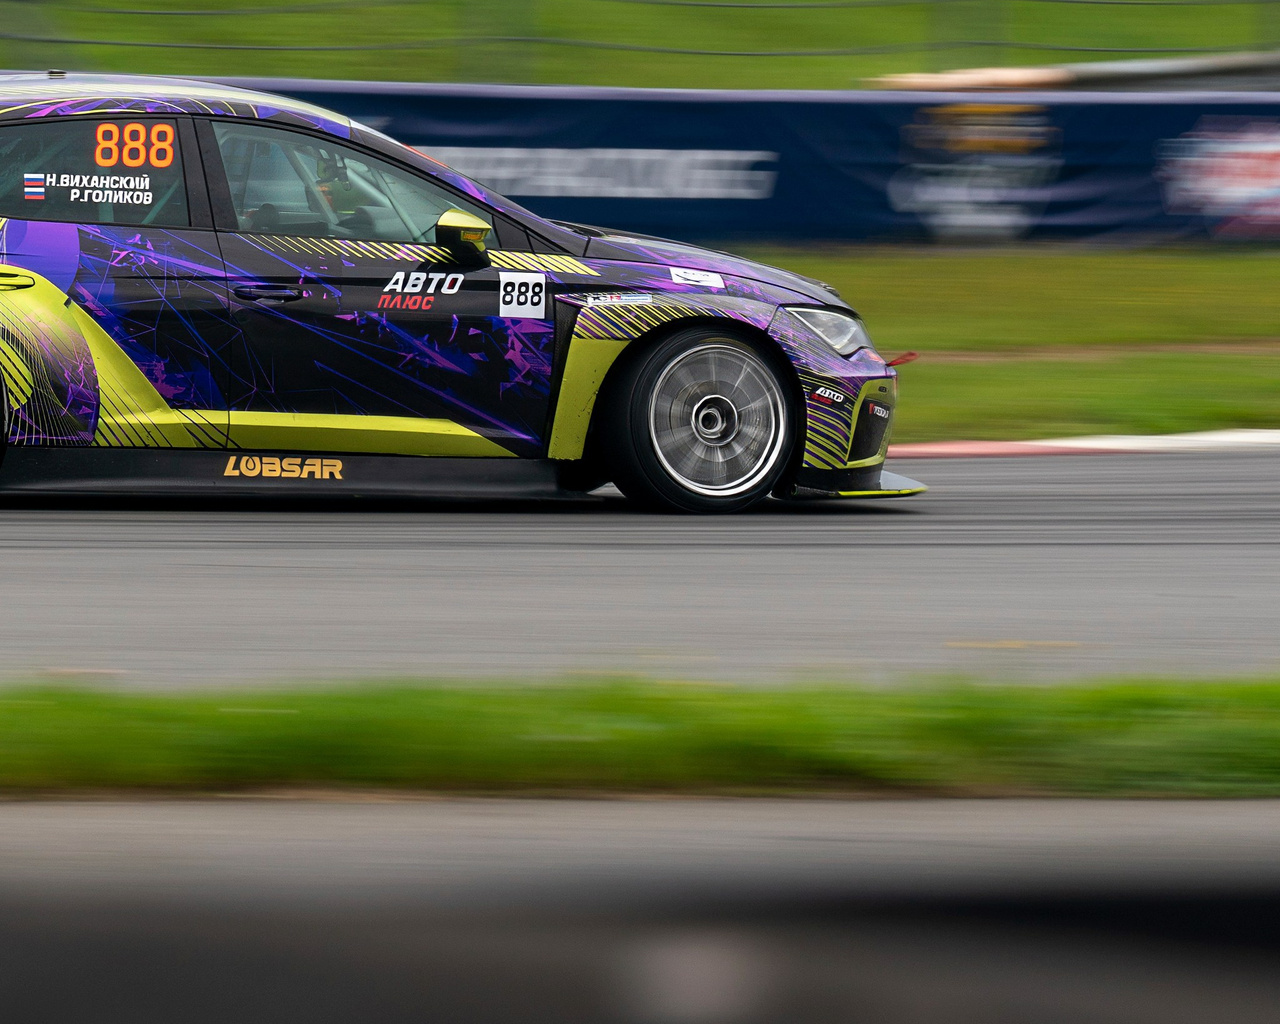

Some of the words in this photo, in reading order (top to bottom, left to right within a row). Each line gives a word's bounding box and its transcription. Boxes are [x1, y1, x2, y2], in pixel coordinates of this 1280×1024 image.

[94, 122, 175, 168] 888
[45, 173, 150, 190] Н.ВИХАНСКИЙ
[70, 188, 153, 205] Р.ГОЛИКОВ
[383, 271, 464, 294] АВТО
[377, 294, 435, 310] ПЛЮС
[501, 281, 544, 307] 888
